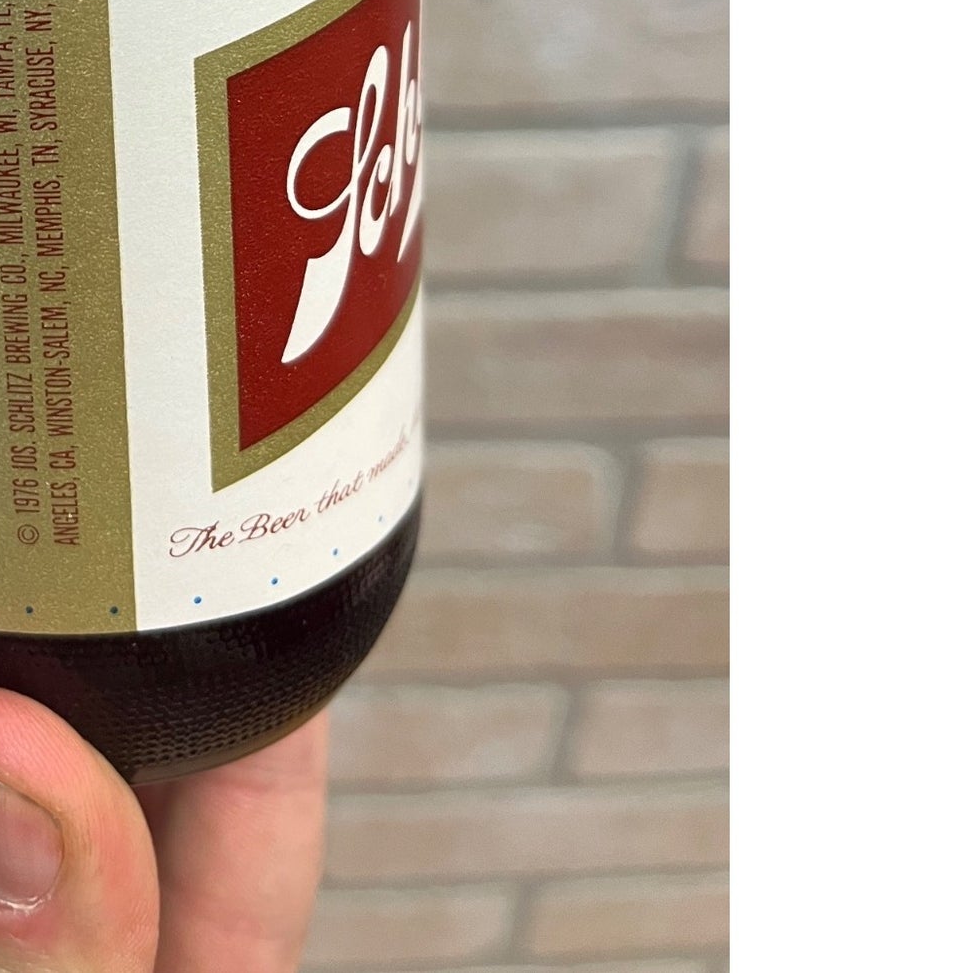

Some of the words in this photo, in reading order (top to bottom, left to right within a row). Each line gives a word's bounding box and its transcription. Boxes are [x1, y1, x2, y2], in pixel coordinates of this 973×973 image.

[23, 3, 57, 32] NY,
[25, 41, 58, 131] SYRACUSE,
[31, 139, 63, 167] TN,
[32, 174, 66, 257] MEMPHIS,
[0, 253, 30, 285] CO.,
[37, 265, 70, 292] NC,
[1, 293, 32, 364] BREWING
[40, 301, 73, 437] WINSTON-SALEM,
[6, 372, 36, 433] SCHLITZ
[10, 441, 38, 471] JOS.
[48, 445, 80, 470] CA,
[12, 478, 40, 514] 1976
[50, 477, 81, 546] ANGELES,
[169, 520, 235, 558] The
[238, 502, 311, 544] Beer
[313, 473, 365, 513] that
